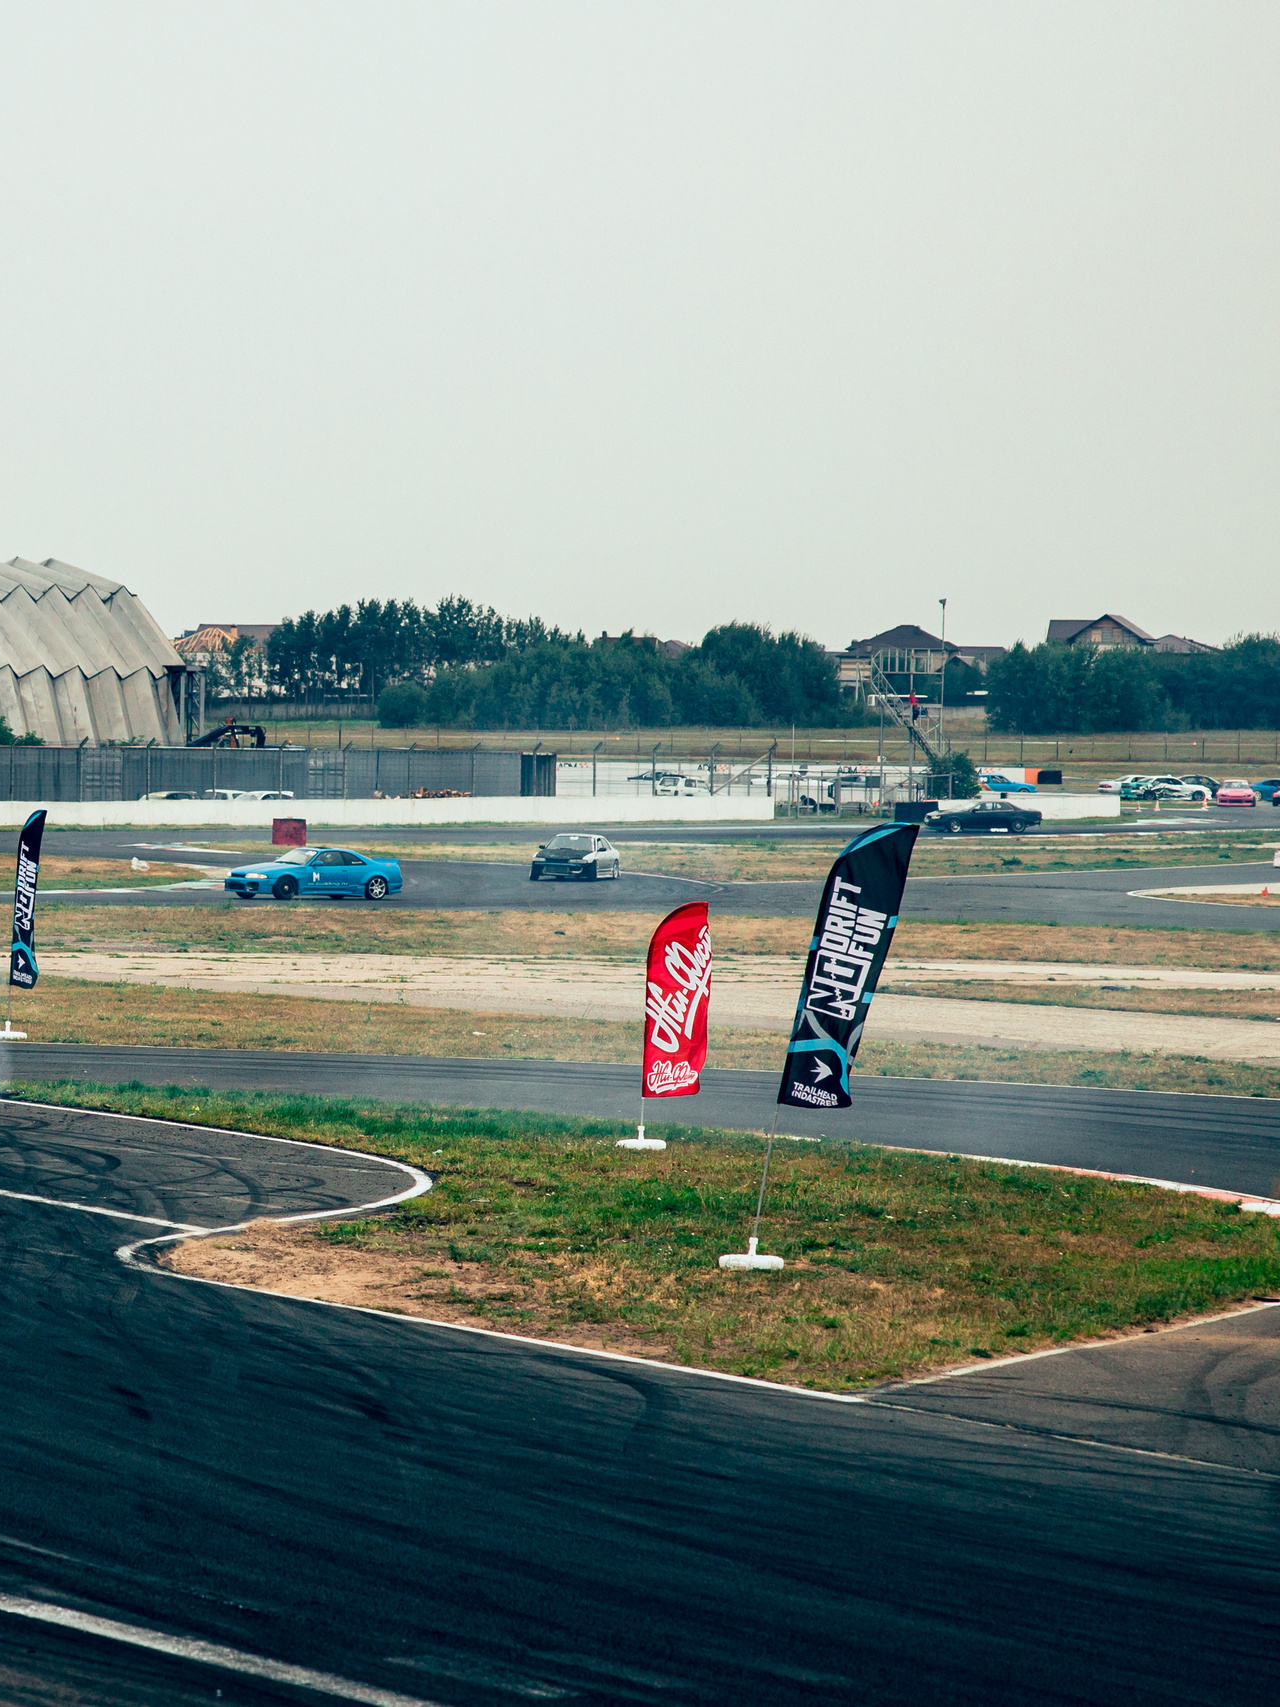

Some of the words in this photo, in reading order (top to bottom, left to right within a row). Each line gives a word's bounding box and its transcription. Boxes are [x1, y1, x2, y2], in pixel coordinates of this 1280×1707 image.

[17, 841, 30, 890] DRIFT
[25, 861, 37, 892] FUN
[820, 876, 862, 949] DRIFT
[847, 907, 888, 961] FUN
[793, 1081, 838, 1101] TRAILHEAD
